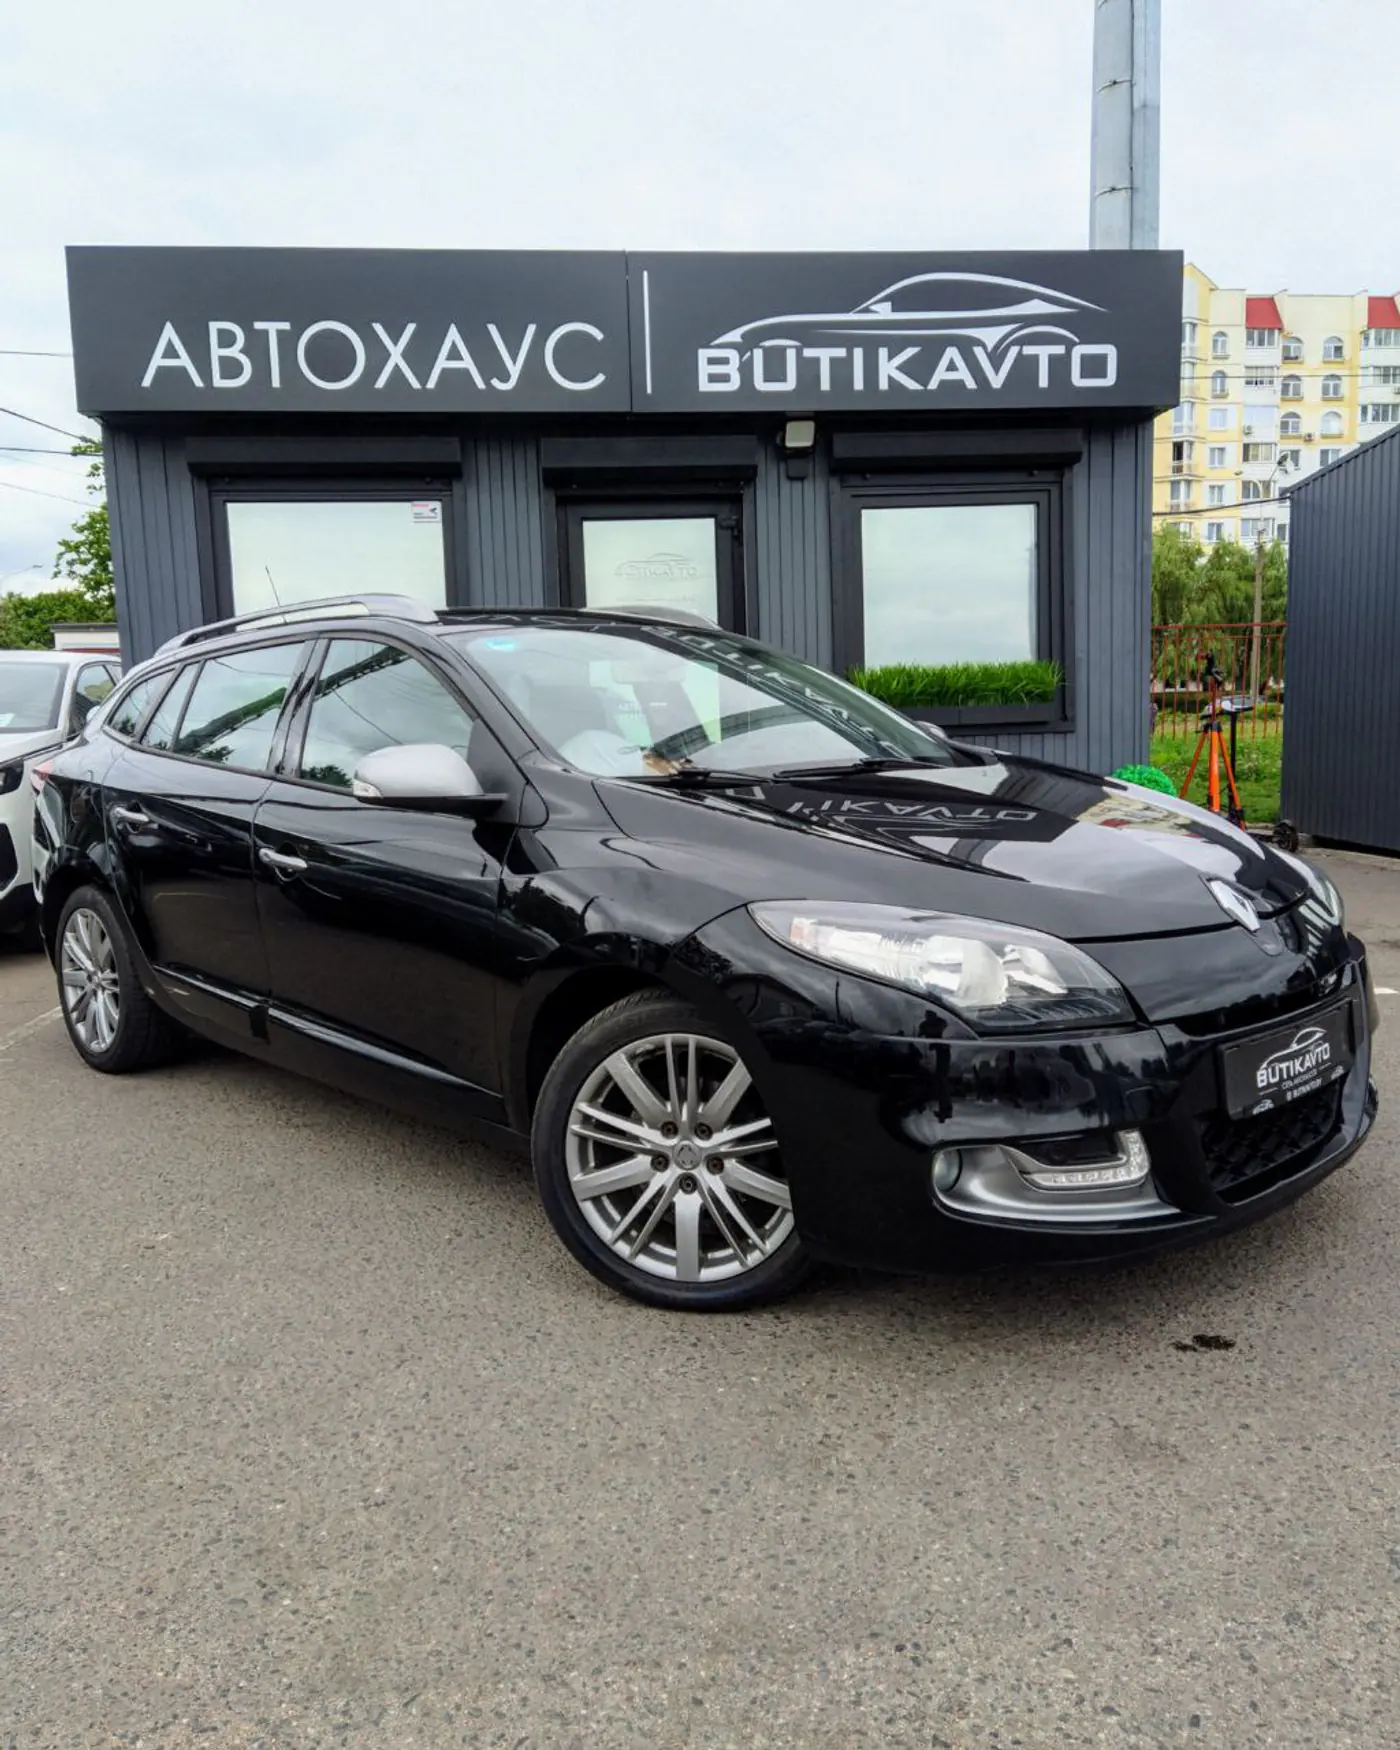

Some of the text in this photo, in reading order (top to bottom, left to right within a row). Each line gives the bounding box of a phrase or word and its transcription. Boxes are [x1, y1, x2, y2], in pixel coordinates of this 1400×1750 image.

[141, 320, 605, 391] АВТОХАУС
[697, 344, 1118, 393] BUTIKAVTO
[1256, 1042, 1331, 1088] BUTIKAVTO
